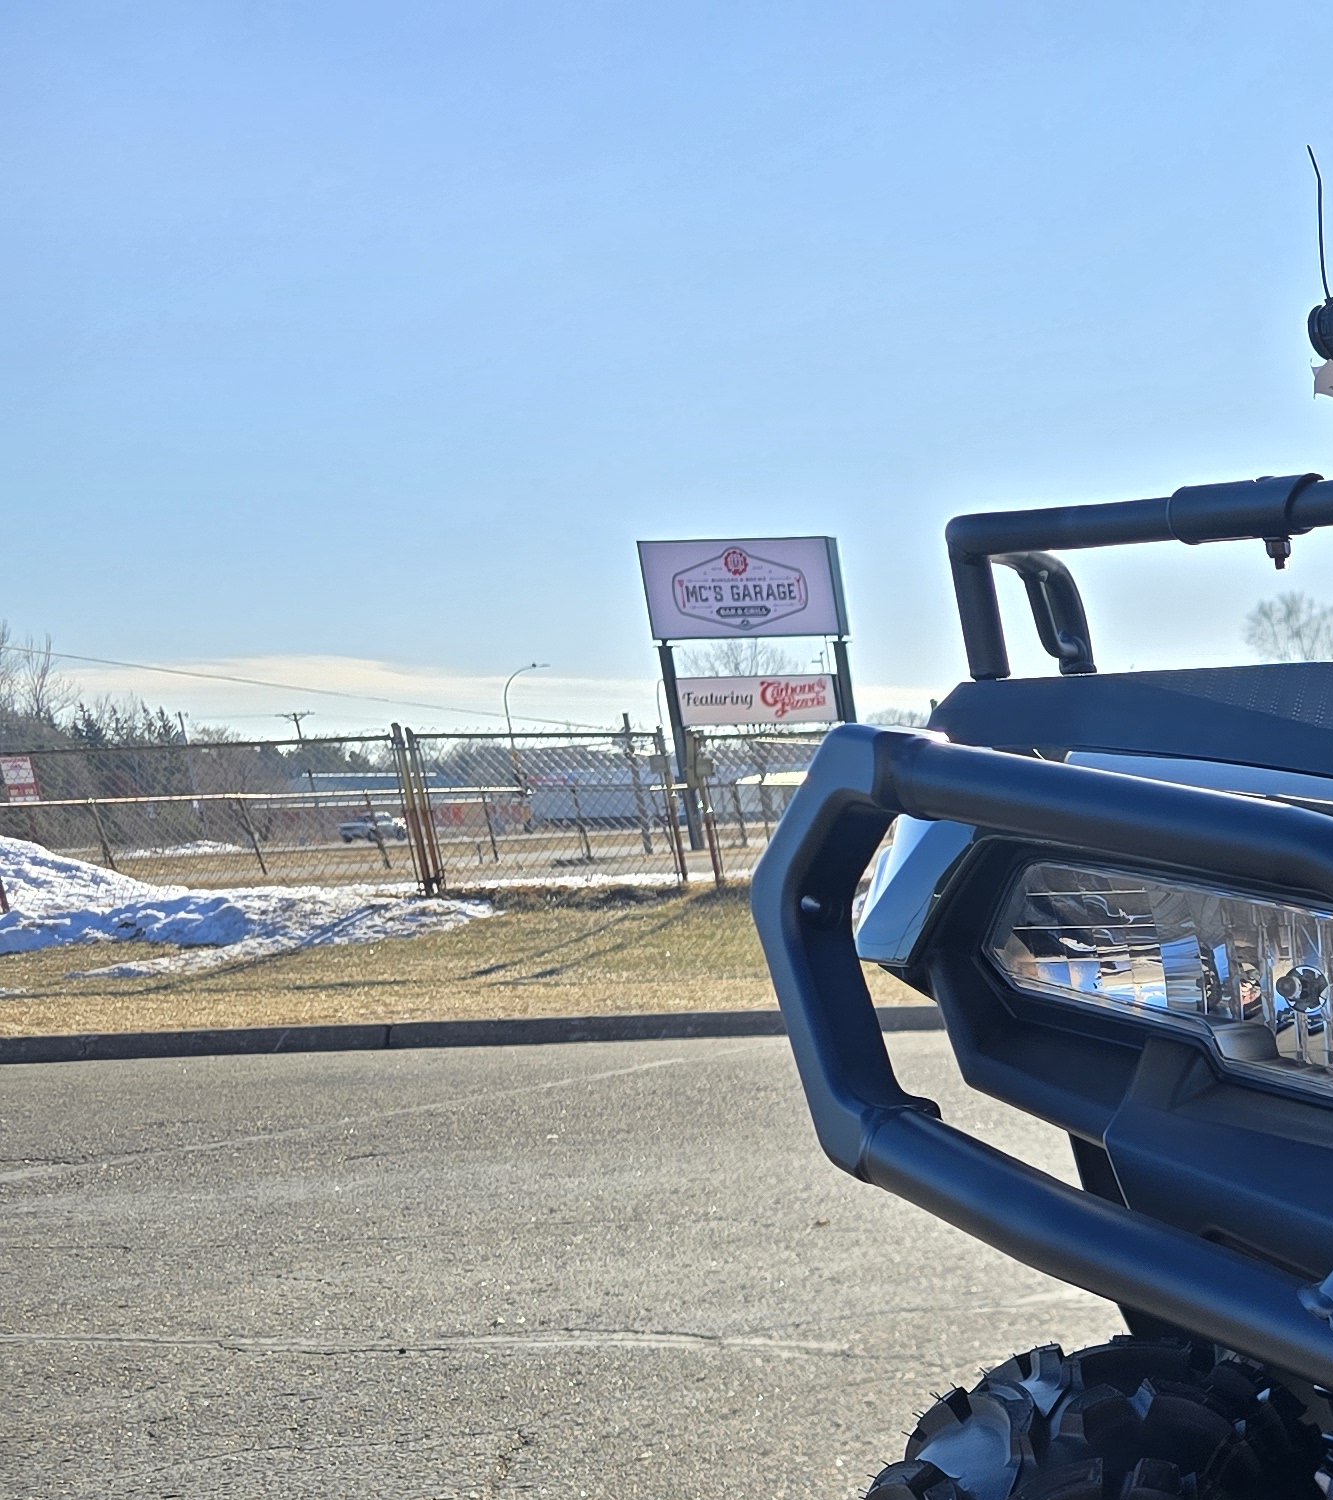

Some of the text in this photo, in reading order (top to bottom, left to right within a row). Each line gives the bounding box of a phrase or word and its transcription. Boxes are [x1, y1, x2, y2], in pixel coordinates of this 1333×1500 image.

[685, 583, 797, 603] MC'S GARAGE
[682, 690, 754, 709] Featuring
